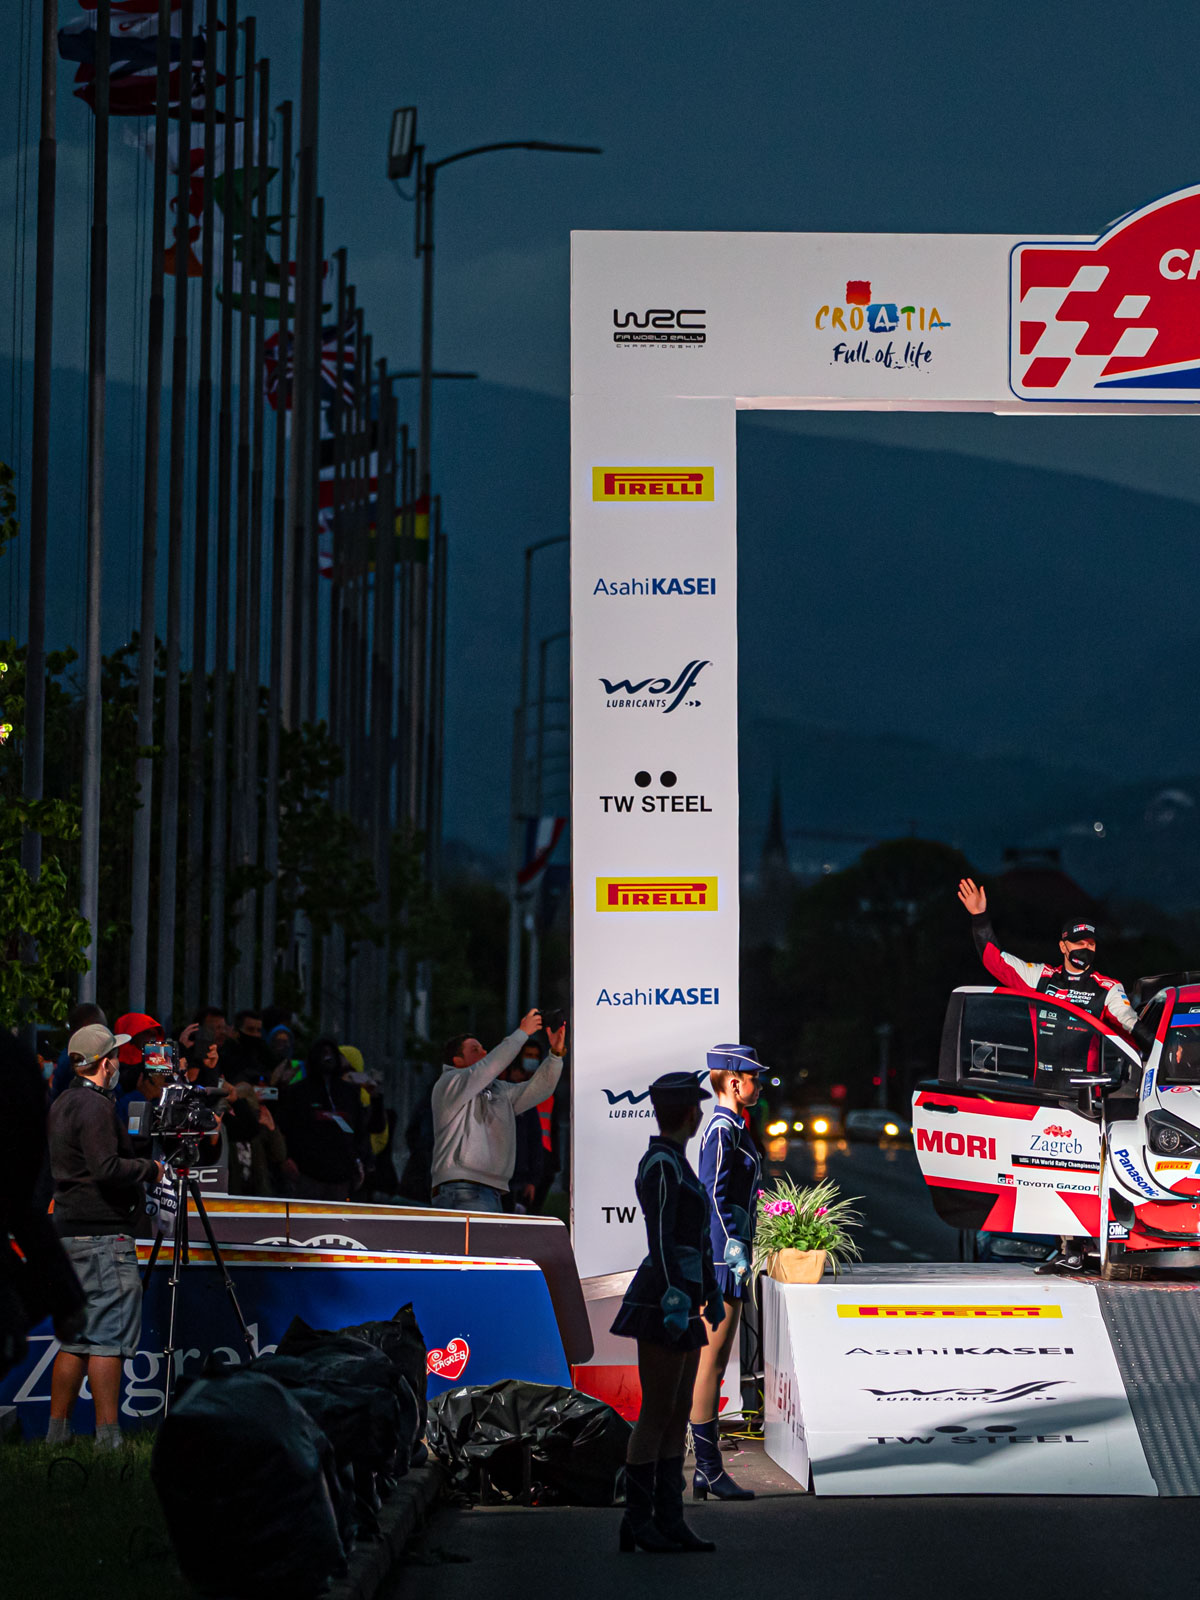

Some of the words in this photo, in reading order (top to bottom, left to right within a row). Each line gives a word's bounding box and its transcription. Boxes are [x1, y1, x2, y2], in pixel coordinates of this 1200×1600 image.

[613, 308, 706, 329] WRC
[815, 304, 951, 332] CROATIA
[875, 341, 896, 369] of
[904, 341, 933, 369] life
[604, 473, 704, 495] PIRELLI
[606, 699, 667, 708] LUBRICANTS
[599, 795, 635, 813] TW
[641, 795, 713, 813] STEEL
[607, 883, 708, 905] PIRELLI
[917, 1128, 997, 1161] MORI
[1030, 1134, 1083, 1157] Zagreb
[1114, 1148, 1160, 1197] Panasonic
[998, 1177, 1015, 1185] GR
[1016, 1179, 1054, 1188] TOYOTA
[1056, 1183, 1091, 1191] GAZOO
[601, 1207, 637, 1224] TW
[1108, 1225, 1128, 1235] OMP
[859, 1306, 1041, 1316] PIRELLI
[433, 1350, 466, 1372] ZAGREB
[868, 1436, 936, 1445] TW
[951, 1434, 1090, 1444] STEEL
